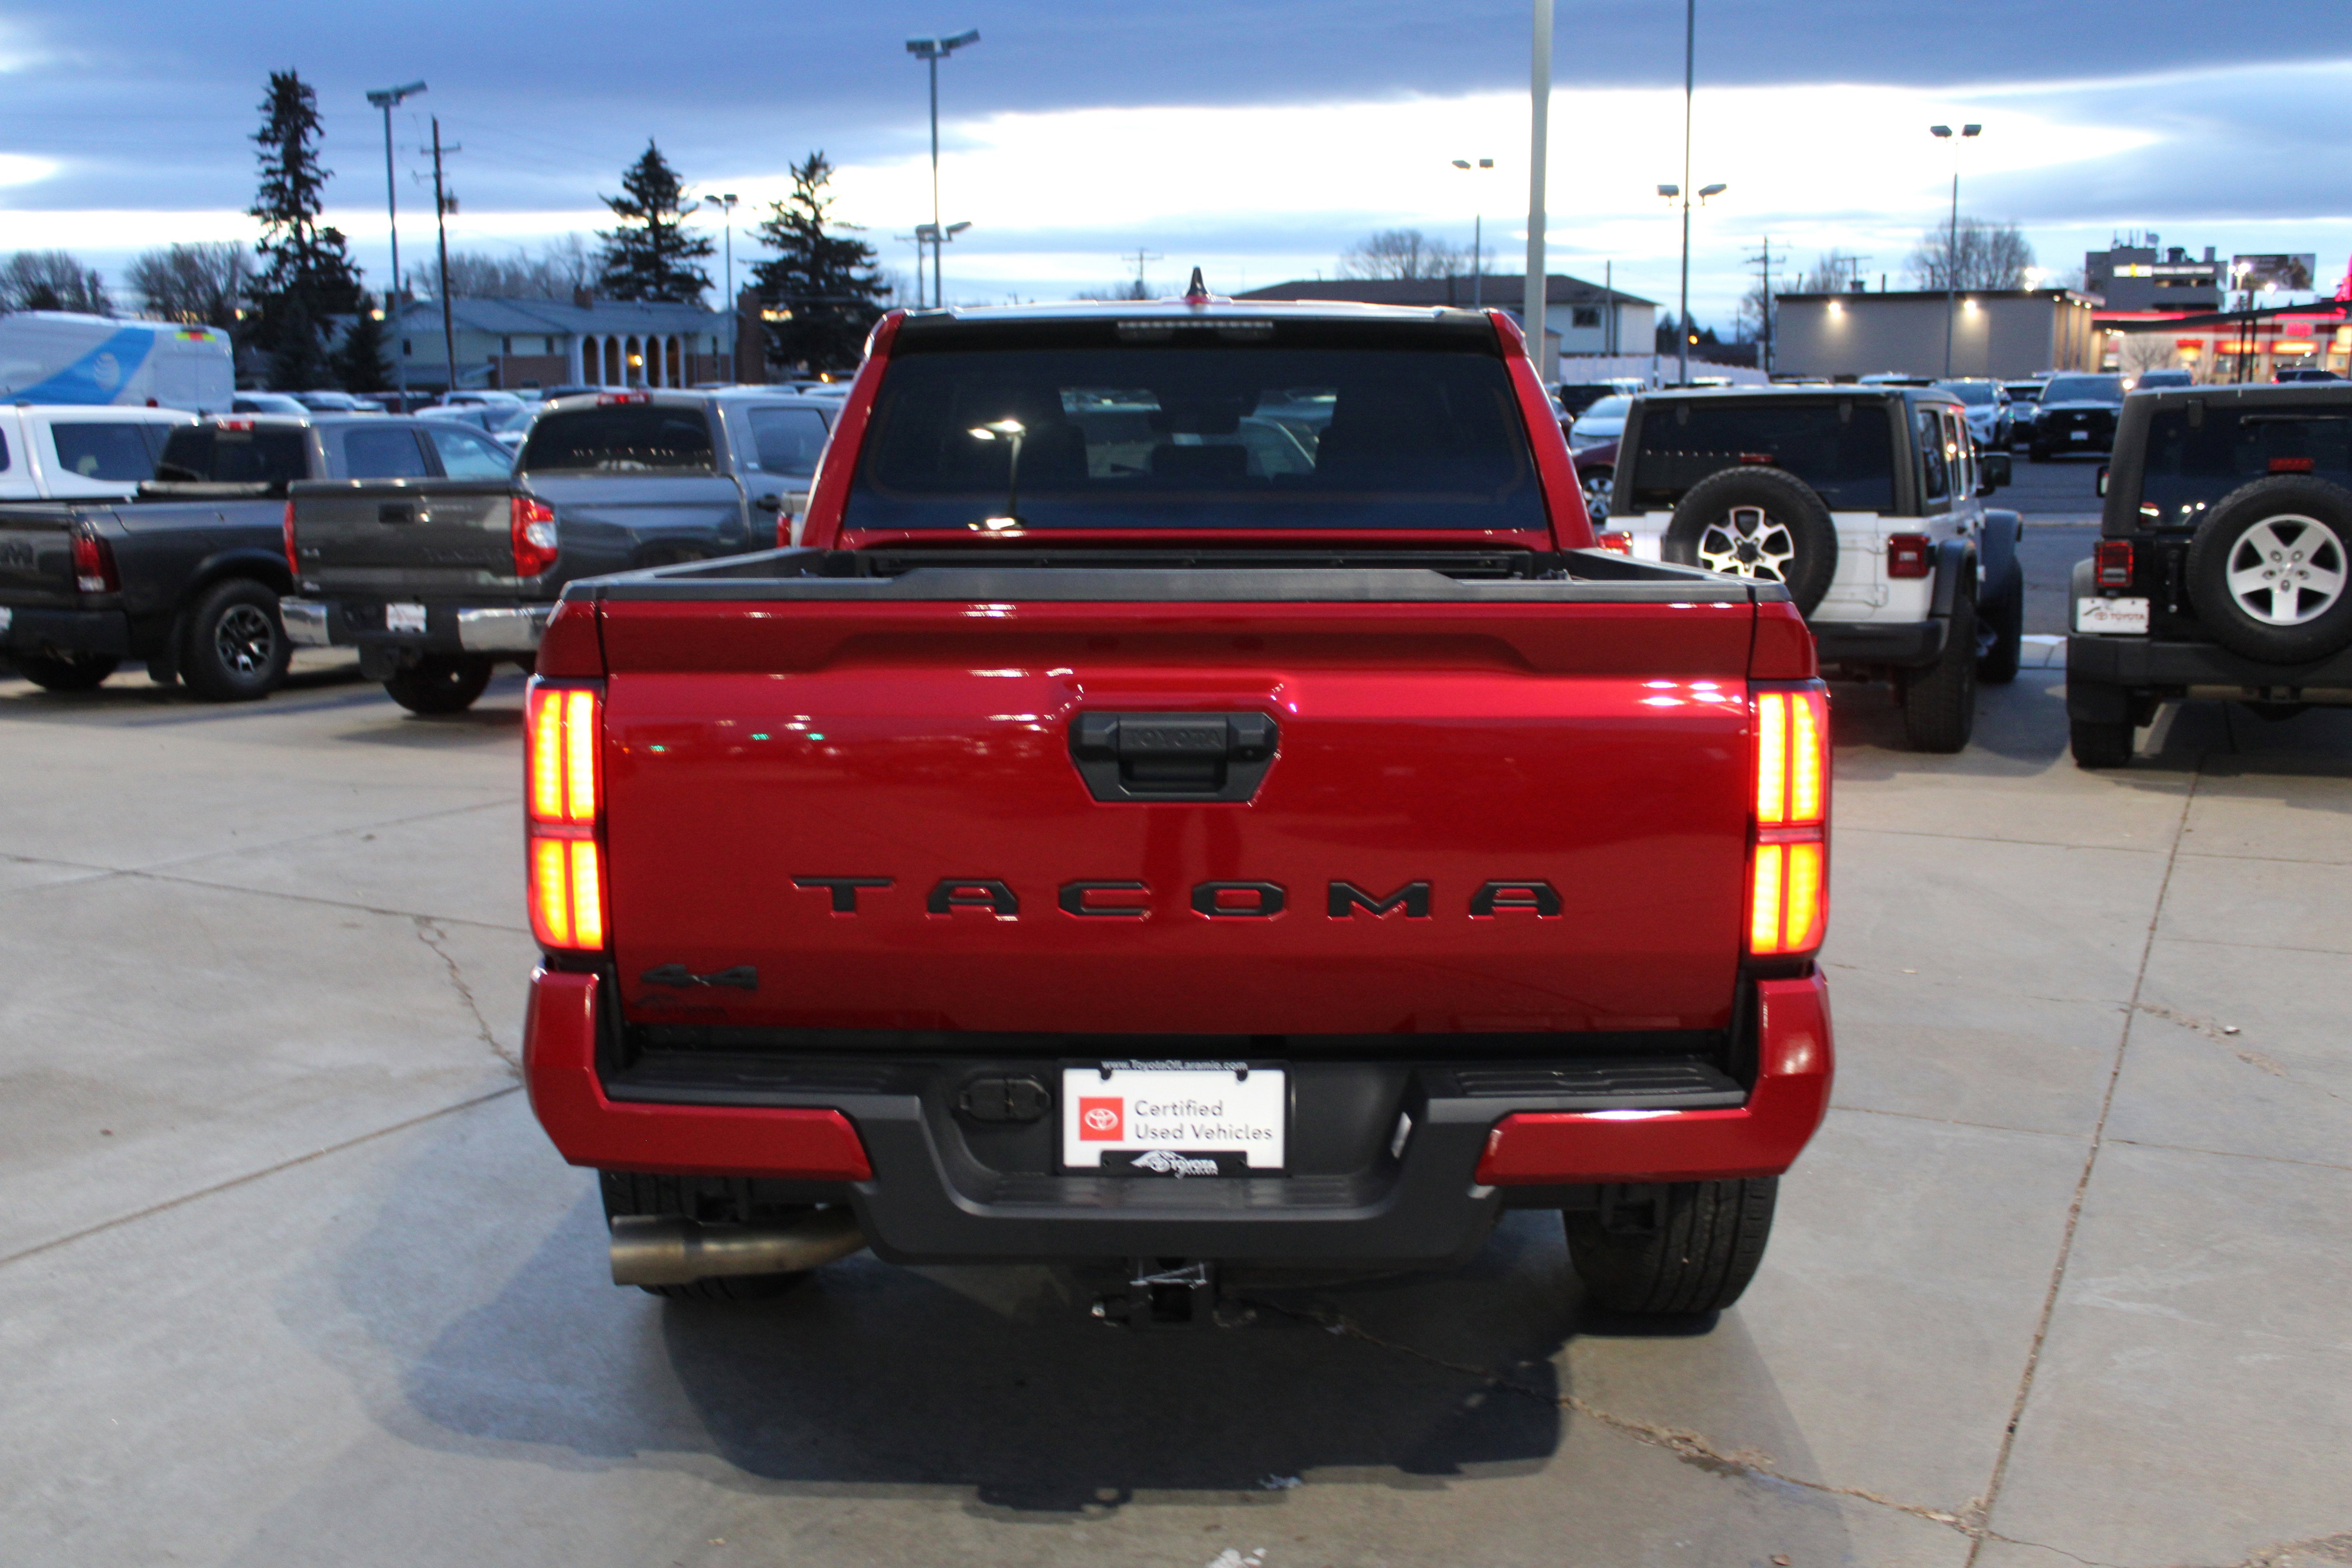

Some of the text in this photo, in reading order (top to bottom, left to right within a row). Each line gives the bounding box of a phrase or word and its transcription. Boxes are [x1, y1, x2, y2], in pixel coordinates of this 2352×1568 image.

[791, 877, 1563, 921] TACOMA
[1135, 1099, 1224, 1116] Certified
[1135, 1123, 1273, 1140] Used Vehicles
